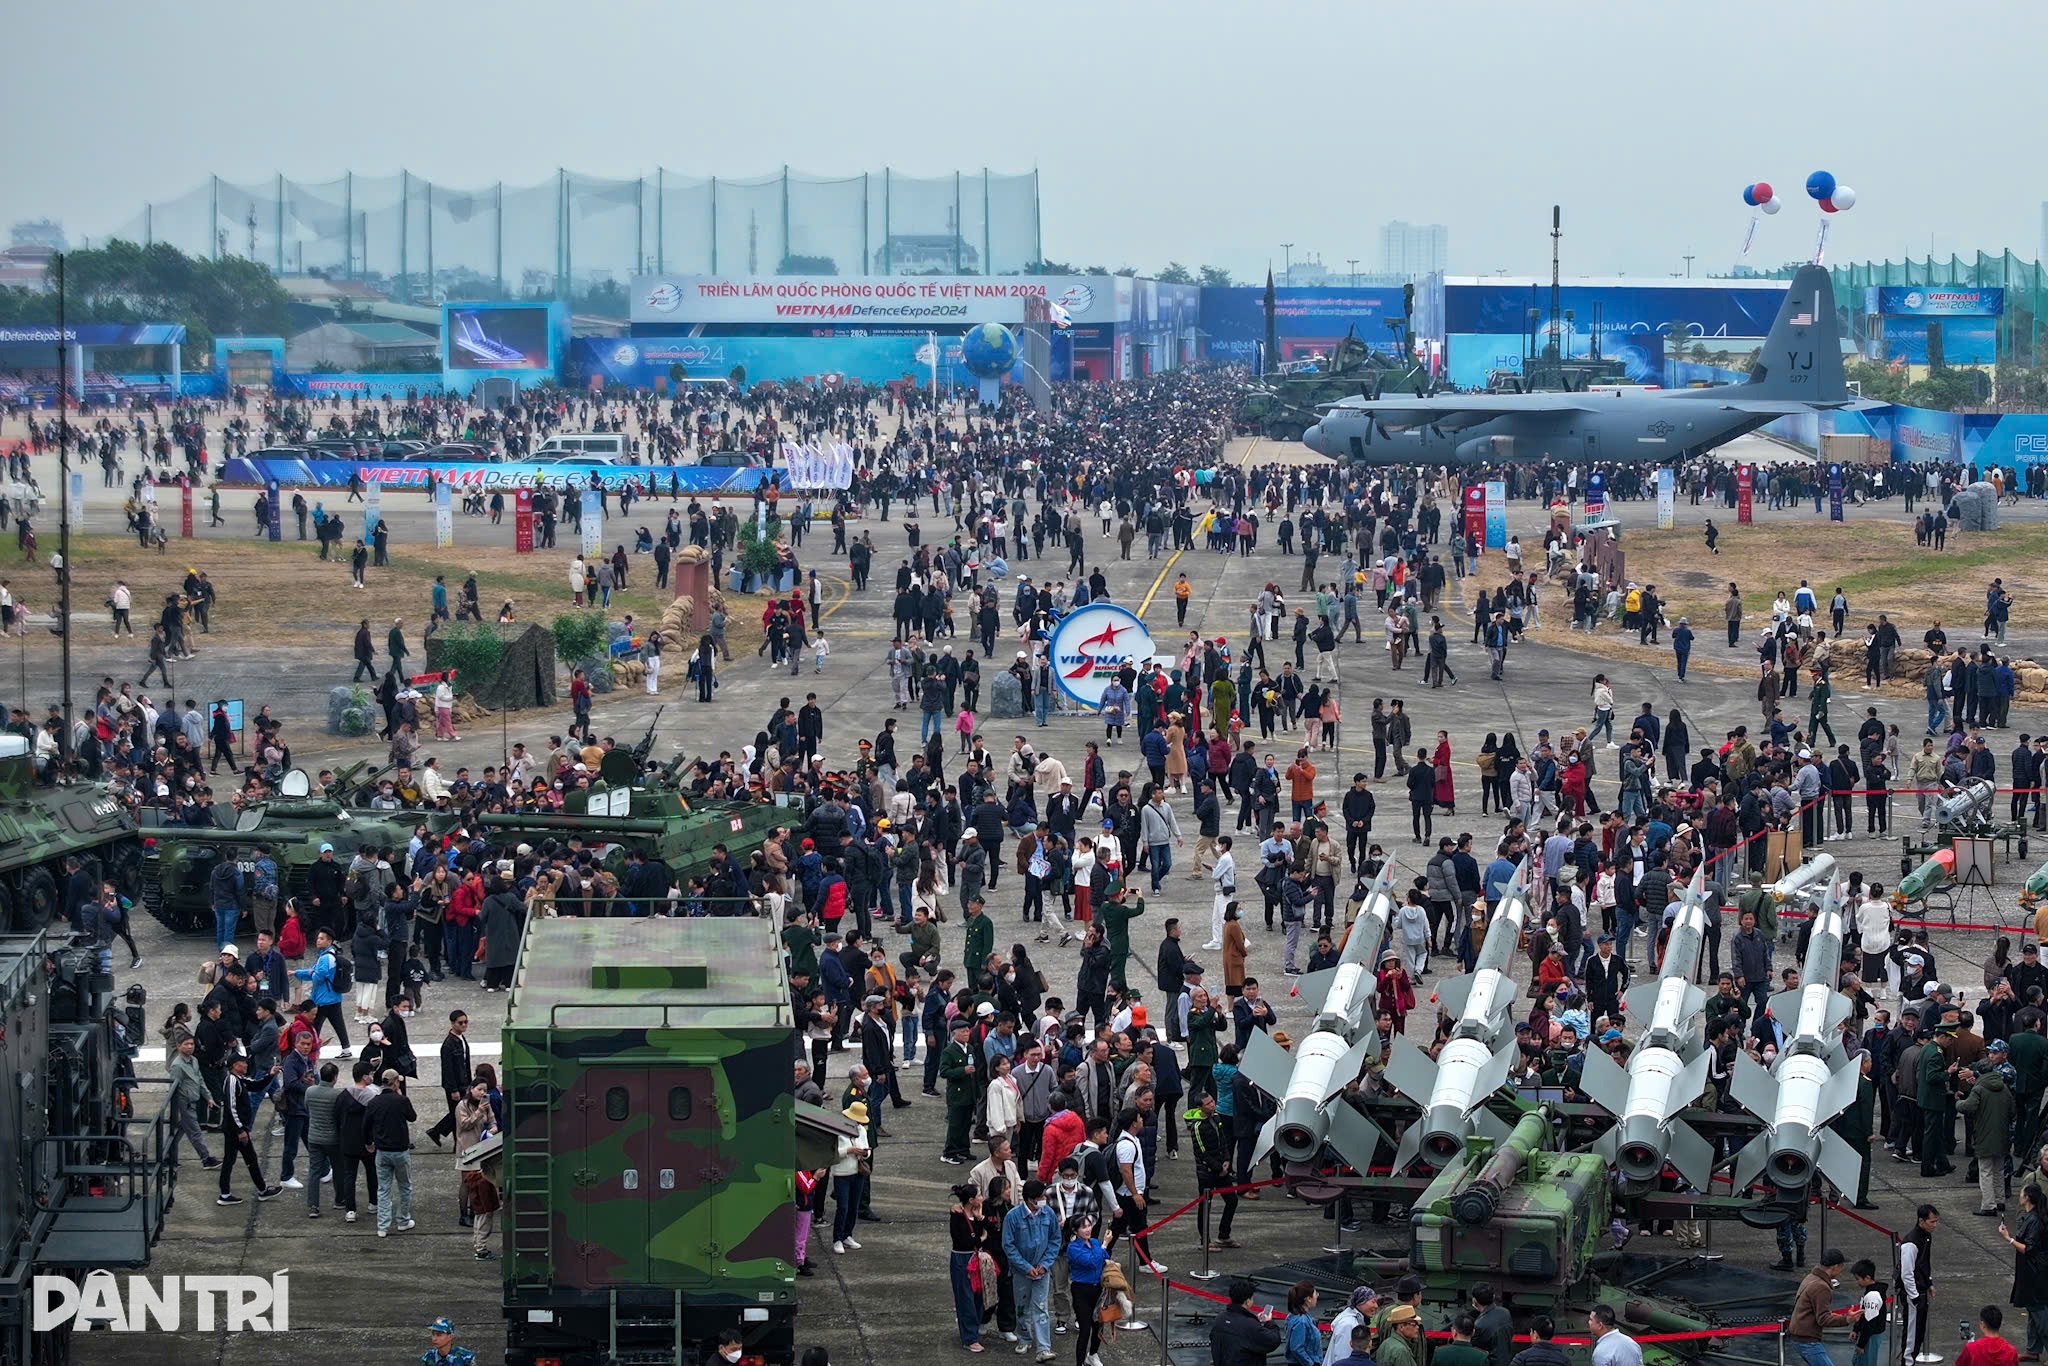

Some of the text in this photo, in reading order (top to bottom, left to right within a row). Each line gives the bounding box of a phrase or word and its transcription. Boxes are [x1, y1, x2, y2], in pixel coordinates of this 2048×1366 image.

[777, 281, 817, 298] QUỐC
[821, 282, 872, 297] PHÒNG
[875, 281, 916, 298] QUỐC
[920, 281, 937, 297] TẾ
[940, 282, 971, 300] VIỆT
[974, 285, 1007, 297] NAM
[1010, 285, 1047, 297] 2024
[1928, 292, 1980, 301] VIETNAM
[1950, 300, 1978, 310] 2024
[1788, 351, 1813, 370] YJ
[2015, 434, 2048, 452] PE
[237, 861, 256, 873] 036
